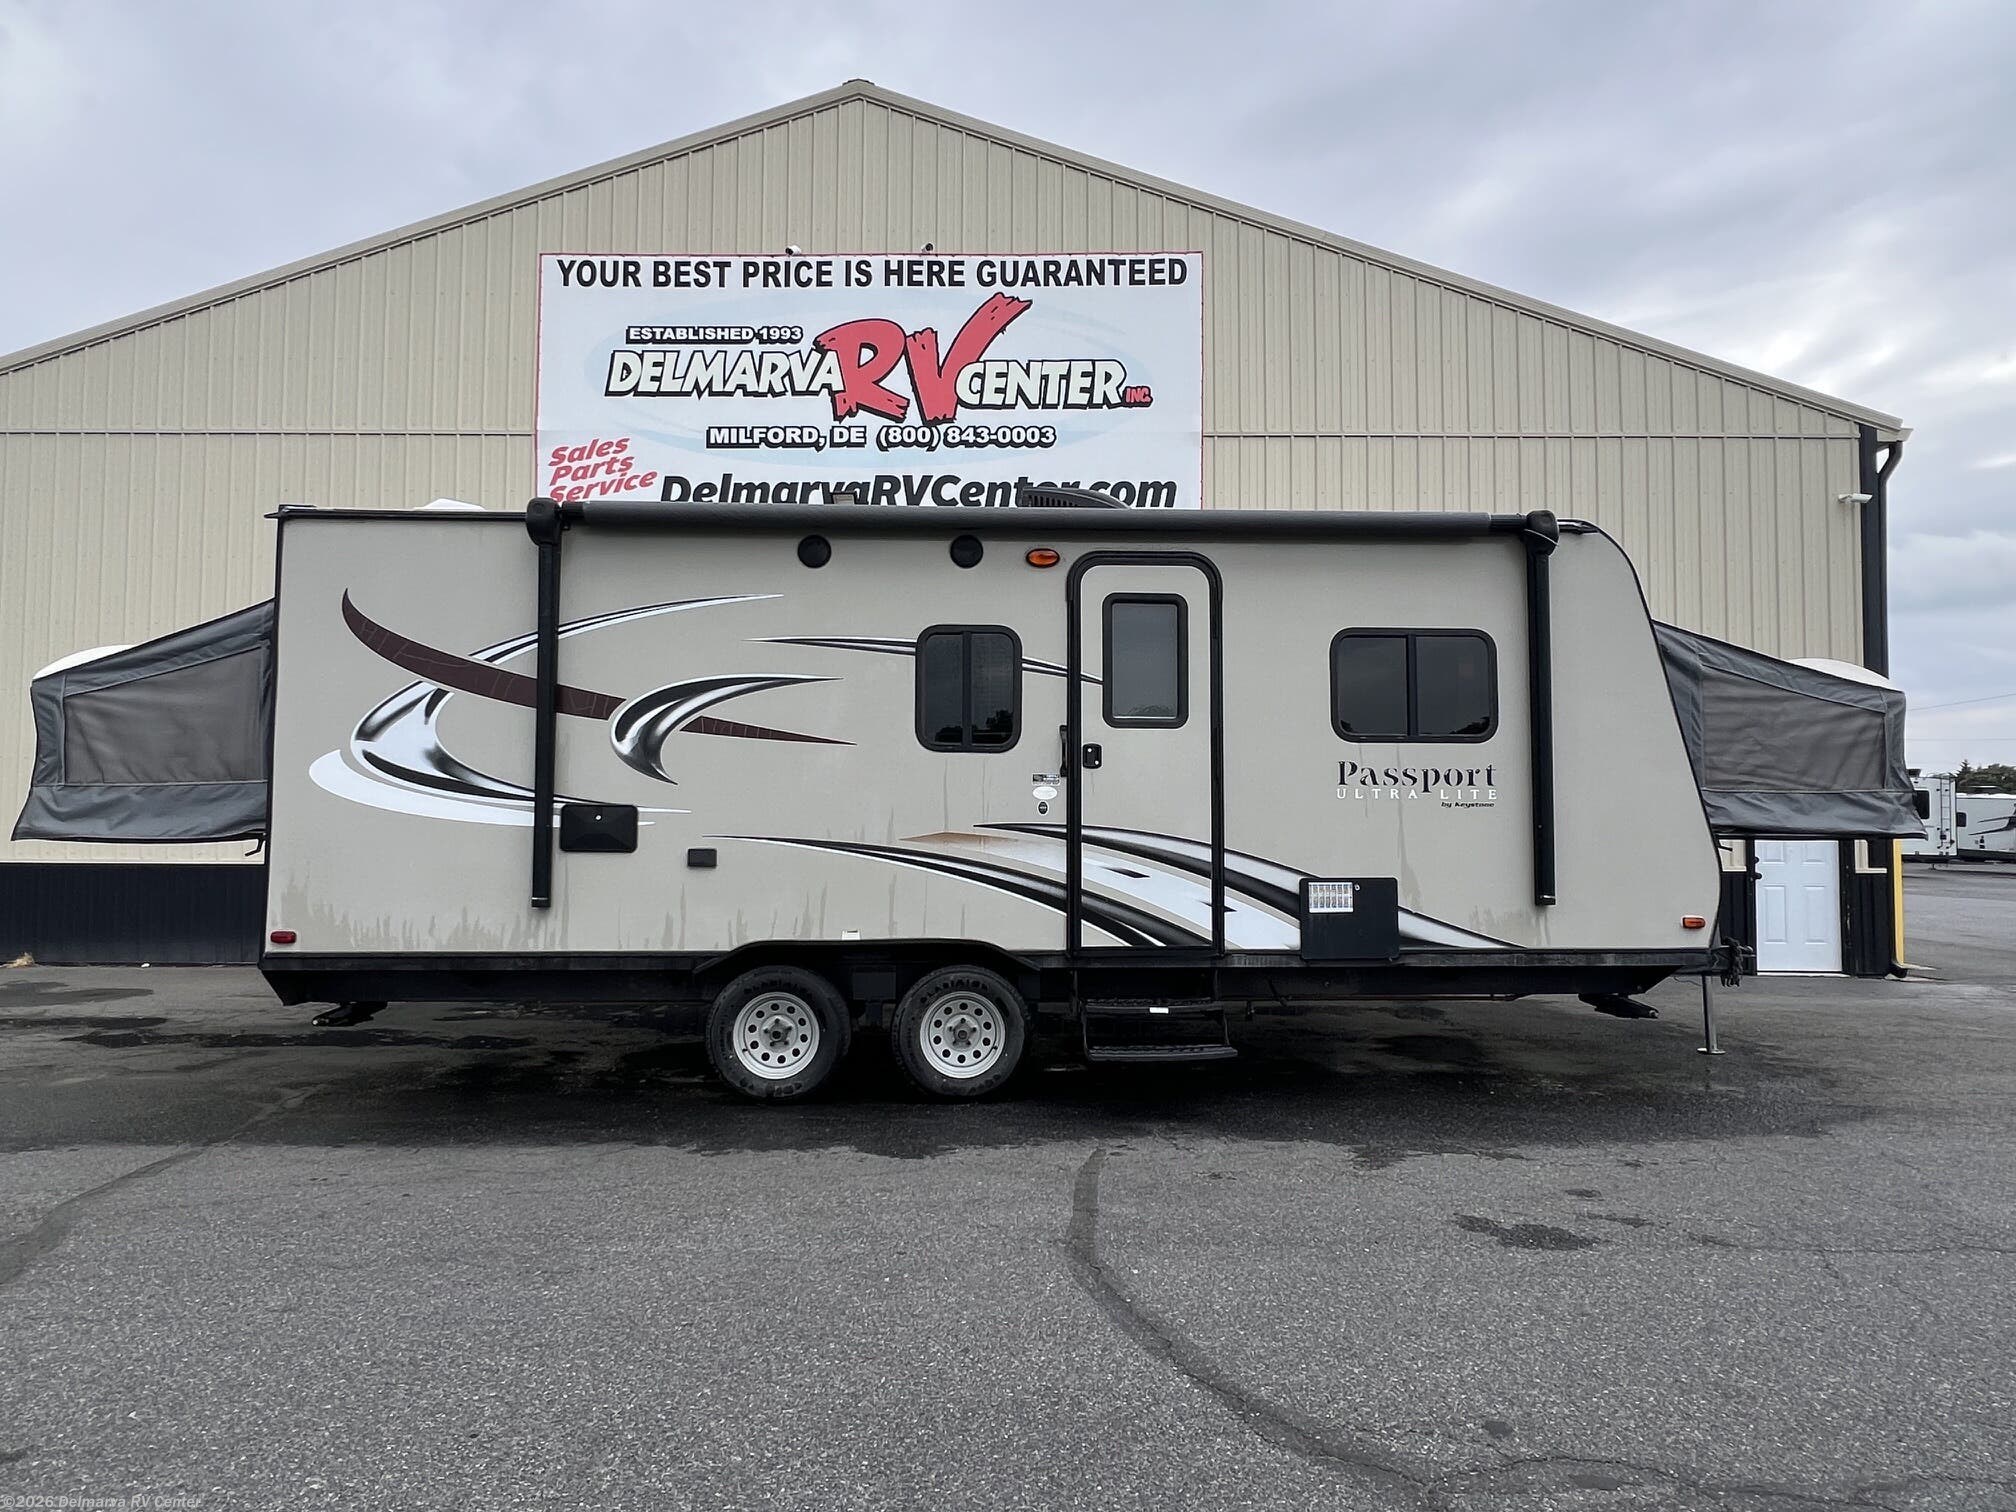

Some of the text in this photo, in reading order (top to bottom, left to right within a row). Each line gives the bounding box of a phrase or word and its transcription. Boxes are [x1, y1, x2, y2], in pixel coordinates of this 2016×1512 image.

[557, 258, 1187, 287] YOUR BEST PRICE IS HERE GUARANTEED
[628, 327, 802, 341] ESTABLISHED 1993
[607, 350, 846, 397] DELMARVA
[815, 292, 1032, 423] RV
[955, 360, 1126, 408] CENTER
[548, 438, 630, 466] Sales
[709, 426, 1055, 450] MILFORD, DE (800) 843-0003
[550, 456, 635, 486] Parts
[550, 471, 658, 502] Service
[1338, 761, 1497, 793] Passport
[1336, 788, 1497, 799] ULTRA LITE
[1441, 801, 1495, 809] by Keystone
